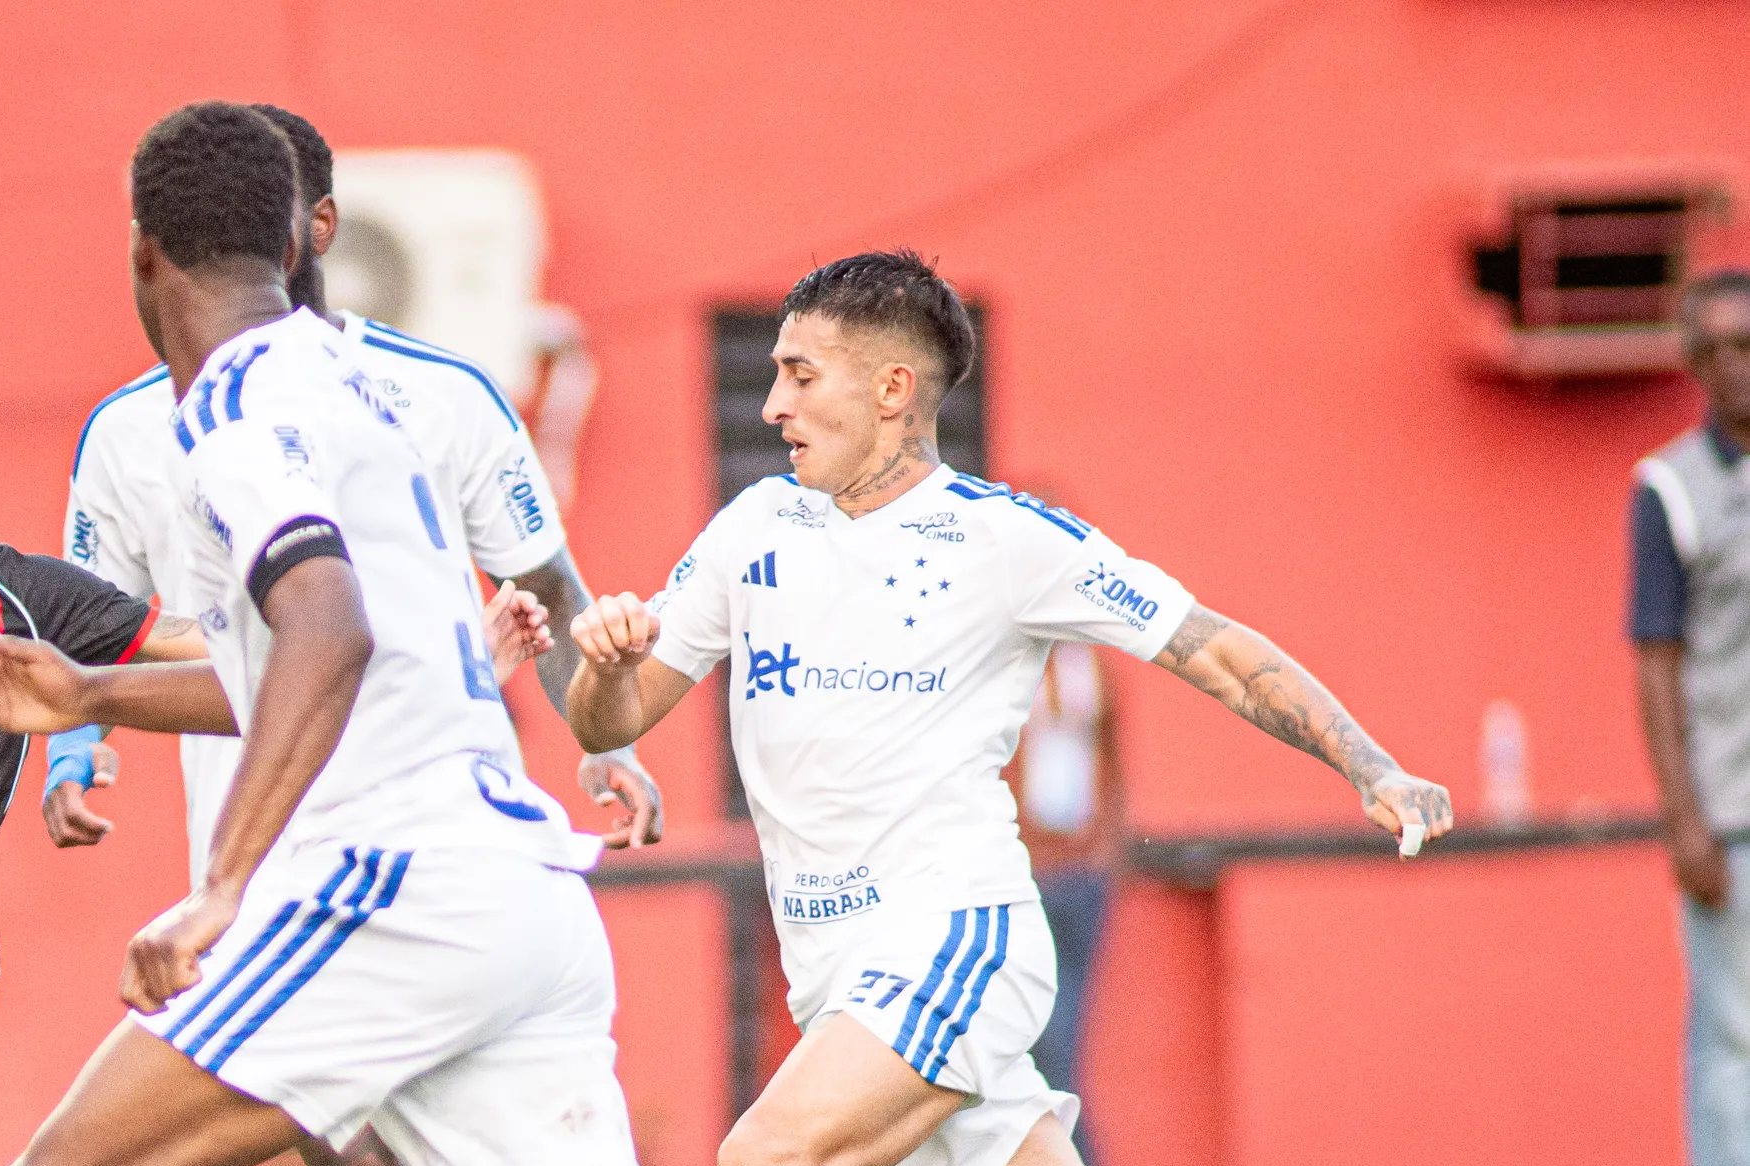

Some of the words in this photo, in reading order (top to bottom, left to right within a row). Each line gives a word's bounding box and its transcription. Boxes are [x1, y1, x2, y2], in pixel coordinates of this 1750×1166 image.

[511, 481, 544, 533] OMO
[925, 530, 966, 543] CIMED
[1074, 583, 1105, 607] CICLO
[1102, 578, 1159, 621] OMO
[803, 661, 947, 693] nacional
[846, 969, 914, 1010] 27
